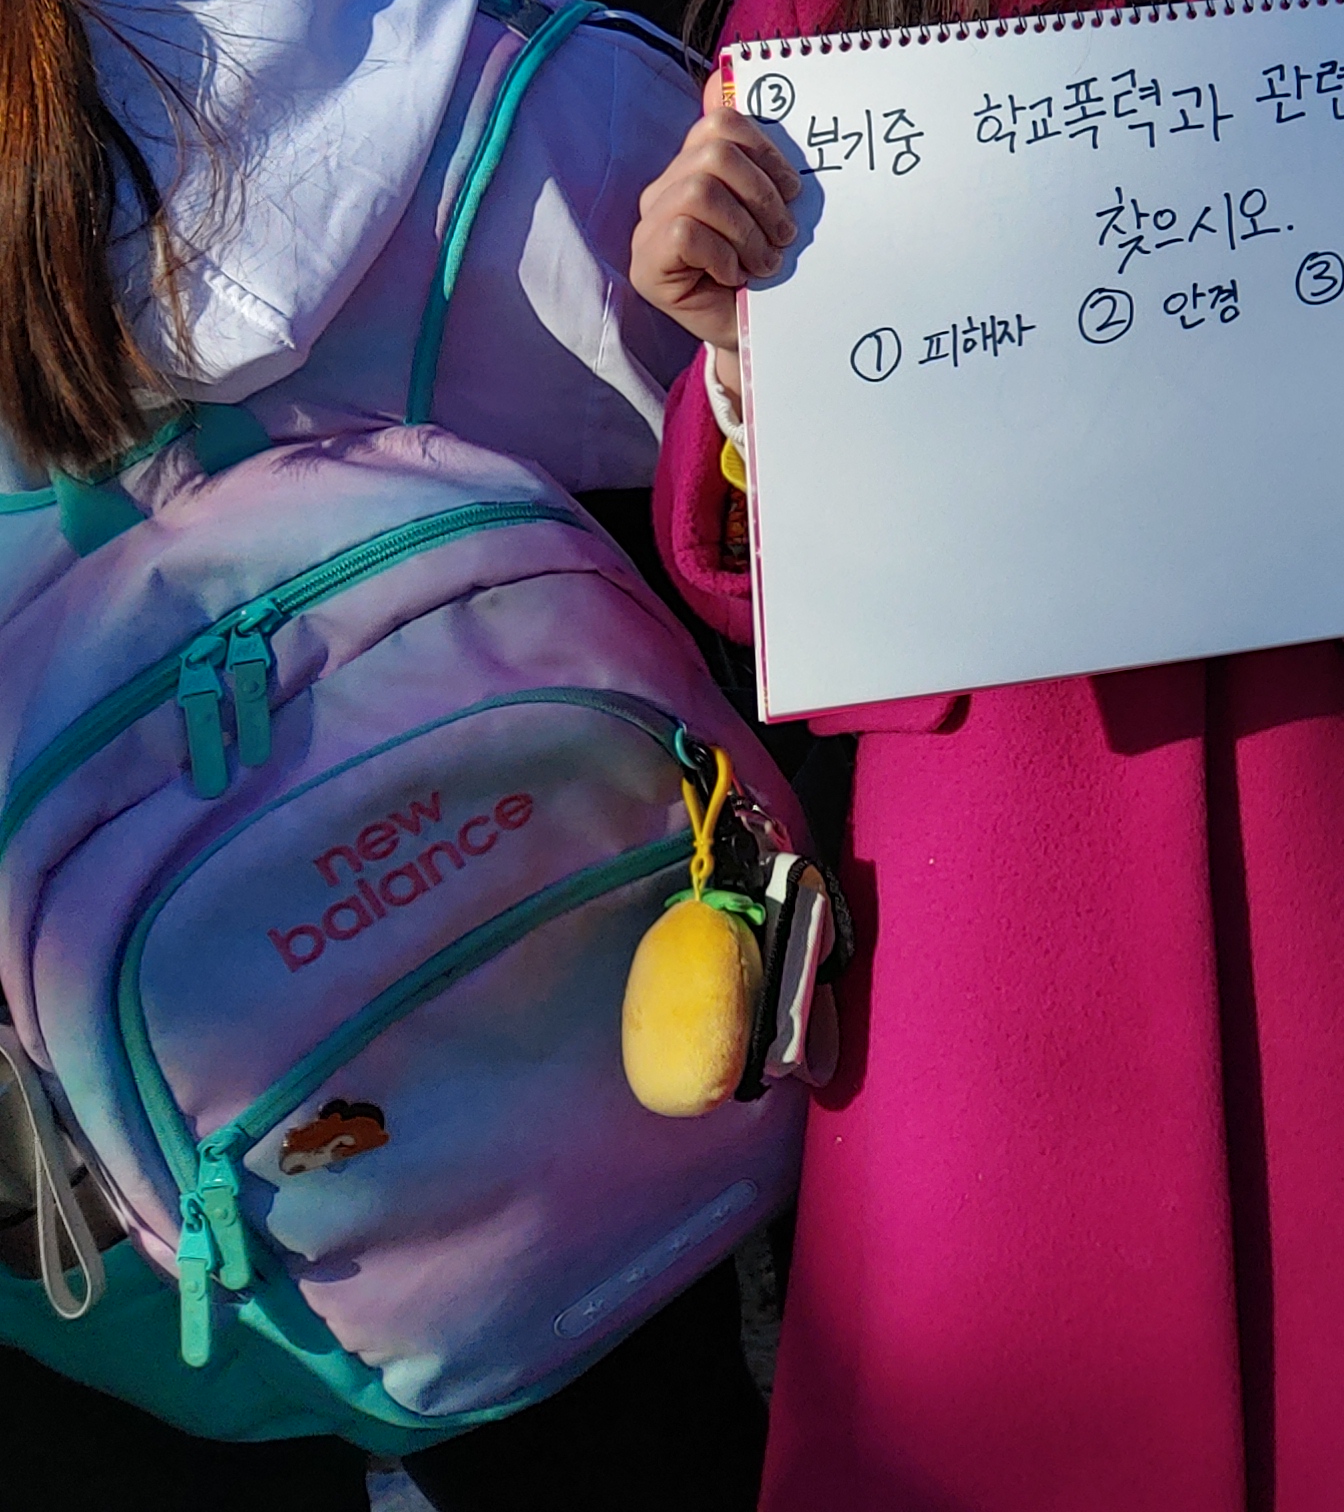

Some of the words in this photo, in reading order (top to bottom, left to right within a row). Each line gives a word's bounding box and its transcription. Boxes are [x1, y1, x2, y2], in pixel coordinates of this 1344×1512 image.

[974, 69, 1234, 153] 학교폭력과
[1096, 187, 1293, 274] 찾으시오.
[918, 314, 1036, 367] 피해자
[1163, 279, 1240, 329] 안경
[268, 791, 534, 972] balance
[312, 791, 446, 887] new
